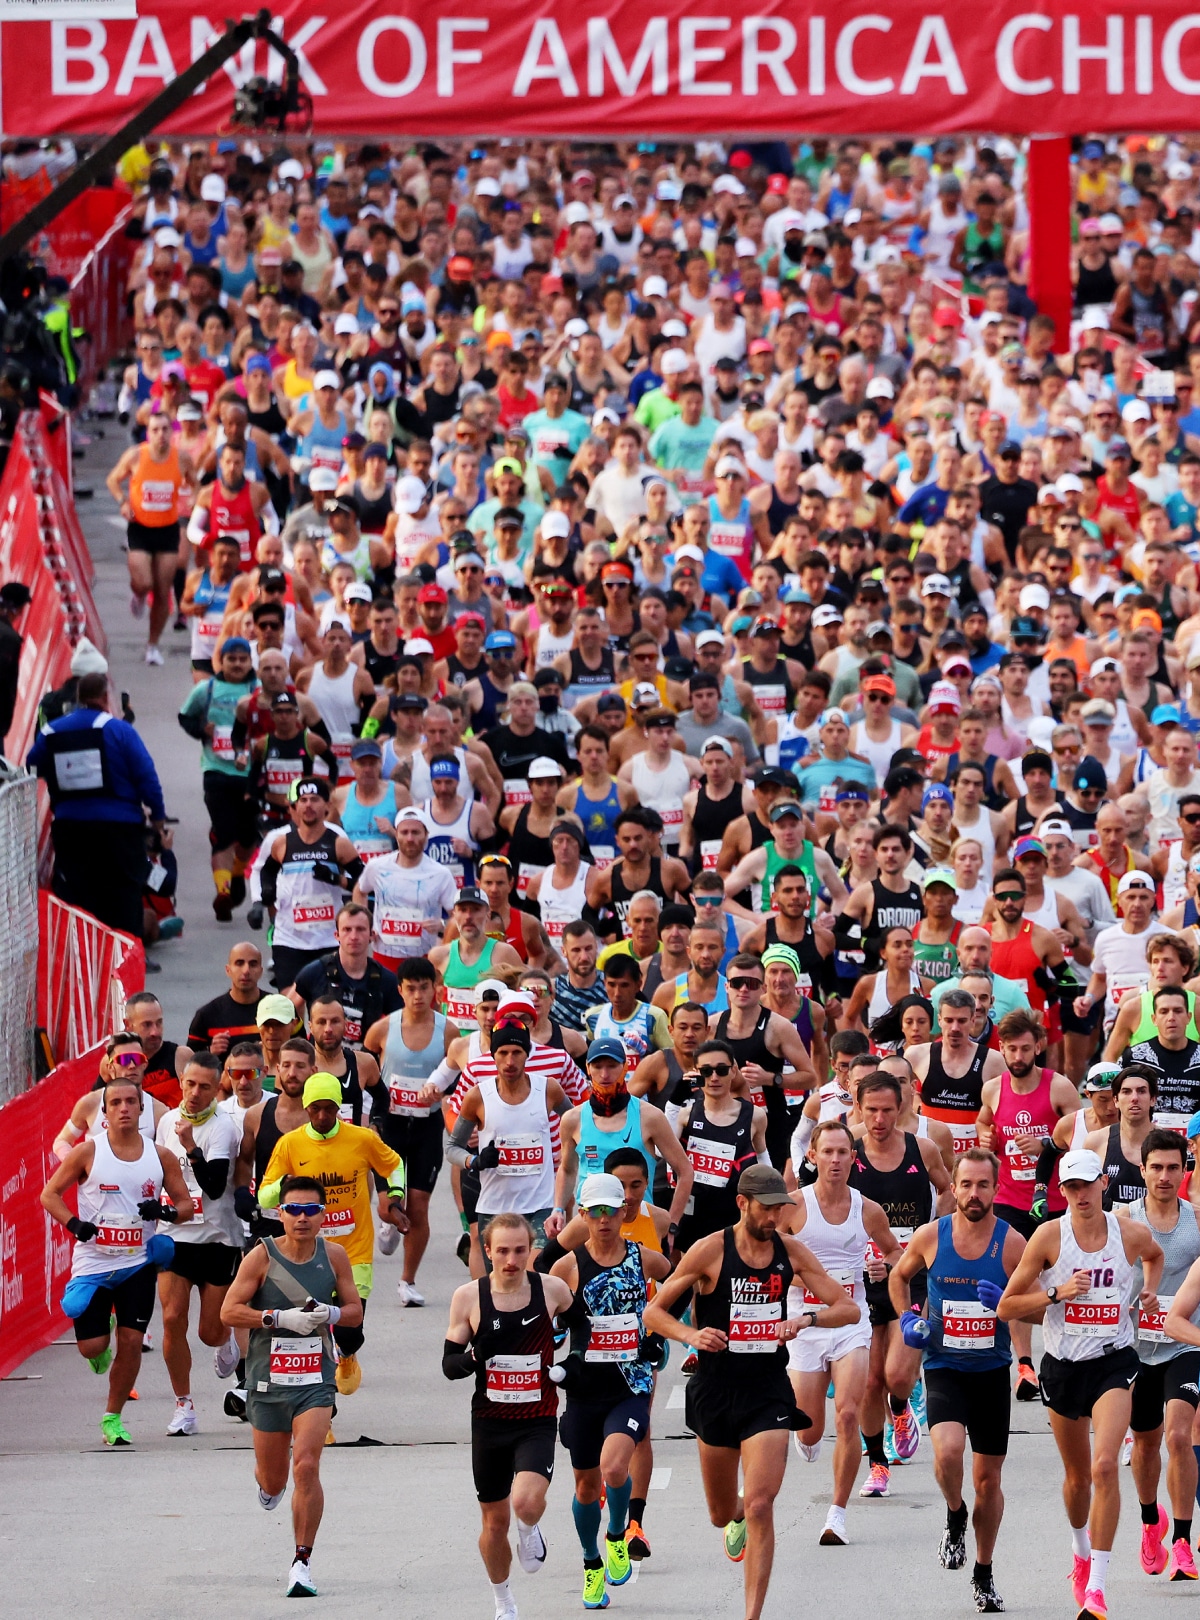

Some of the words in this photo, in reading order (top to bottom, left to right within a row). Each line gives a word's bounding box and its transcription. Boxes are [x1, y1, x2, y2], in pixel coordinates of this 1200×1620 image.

[50, 17, 328, 96] BANK
[356, 16, 489, 98] OF
[512, 15, 968, 97] AMERICA
[292, 852, 328, 862] CHICAGO
[294, 909, 303, 919] A
[306, 907, 332, 919] 9001
[877, 908, 921, 928] DROMO
[383, 922, 391, 931] A
[394, 921, 421, 933] 5017
[390, 1090, 397, 1101] A
[937, 1089, 969, 1100] Marshall
[947, 1099, 966, 1107] Keynes
[1003, 1124, 1048, 1136] fitmums
[499, 1151, 507, 1160] A
[511, 1149, 542, 1160] 3169
[697, 1157, 730, 1172] 3196
[325, 1186, 350, 1195] CAGO
[325, 1198, 339, 1206] UN
[882, 1202, 916, 1213] OMAS
[890, 1214, 919, 1226] ANCE
[98, 1229, 106, 1240] A
[110, 1228, 141, 1242] 1010
[730, 1277, 762, 1292] WEST
[944, 1277, 970, 1285] SWEAT
[731, 1293, 770, 1304] VALLEY
[1066, 1307, 1075, 1317] A
[1078, 1306, 1118, 1318] 20158
[731, 1325, 740, 1335] A
[945, 1321, 953, 1330] A
[957, 1320, 994, 1331] 21063
[599, 1332, 637, 1345] 25284
[272, 1356, 281, 1367] A
[284, 1356, 320, 1367] 20115
[488, 1374, 496, 1384] A
[500, 1373, 539, 1385] 18054
